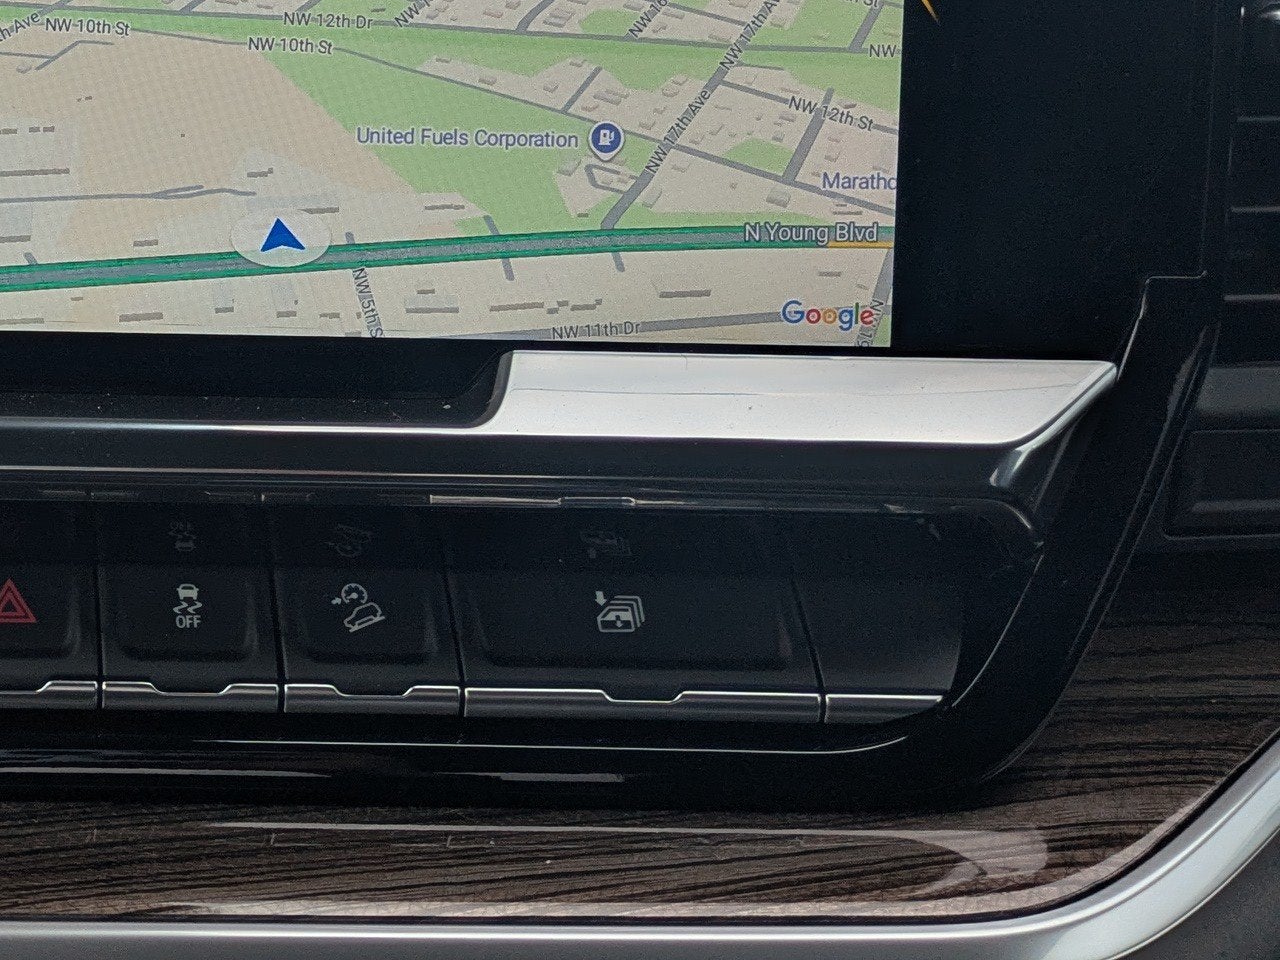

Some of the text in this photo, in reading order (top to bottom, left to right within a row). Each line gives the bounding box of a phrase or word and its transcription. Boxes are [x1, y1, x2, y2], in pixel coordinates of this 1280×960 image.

[9, 10, 42, 33] Ave
[44, 17, 131, 37] NW 10th St
[283, 11, 374, 30] NW 12th Dr
[394, 3, 420, 28] NW
[628, 13, 652, 38] NW
[248, 36, 333, 55] NW 10th St
[719, 42, 743, 71] NW
[740, 12, 768, 42] 17th
[869, 44, 897, 58] NW
[788, 95, 874, 132] NW 12th St
[356, 127, 579, 152] United Fuels Corporation
[646, 89, 711, 174] NW 17th Ave
[744, 221, 879, 246] N Young Blvd
[352, 267, 372, 296] NW
[361, 297, 379, 327] 5th
[782, 299, 875, 332] Google
[552, 321, 641, 340] NW 11th Dr
[175, 614, 202, 630] OFF
